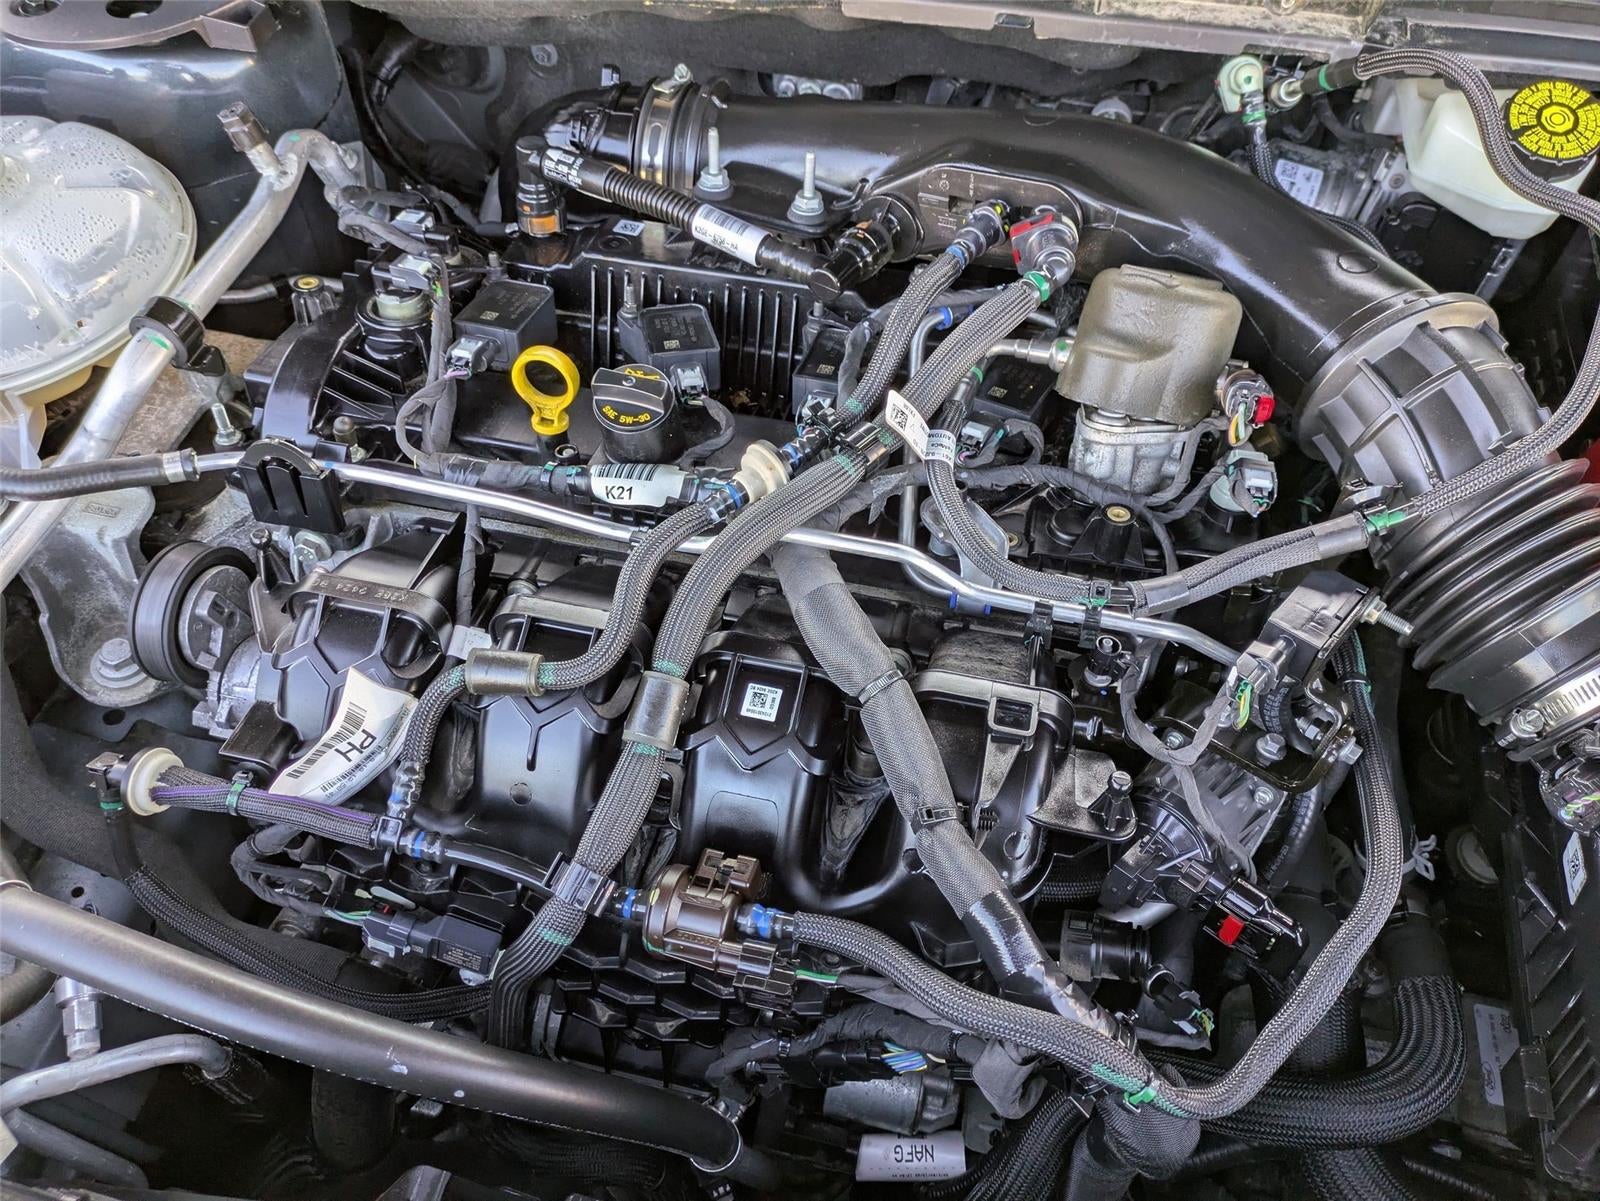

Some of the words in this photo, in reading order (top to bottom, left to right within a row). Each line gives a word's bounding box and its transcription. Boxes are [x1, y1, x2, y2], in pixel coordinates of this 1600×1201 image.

[602, 405, 618, 420] SAE
[619, 412, 651, 424] 5W-30
[604, 485, 633, 500] K21
[334, 728, 377, 762] PH
[894, 1144, 935, 1163] NAFG
